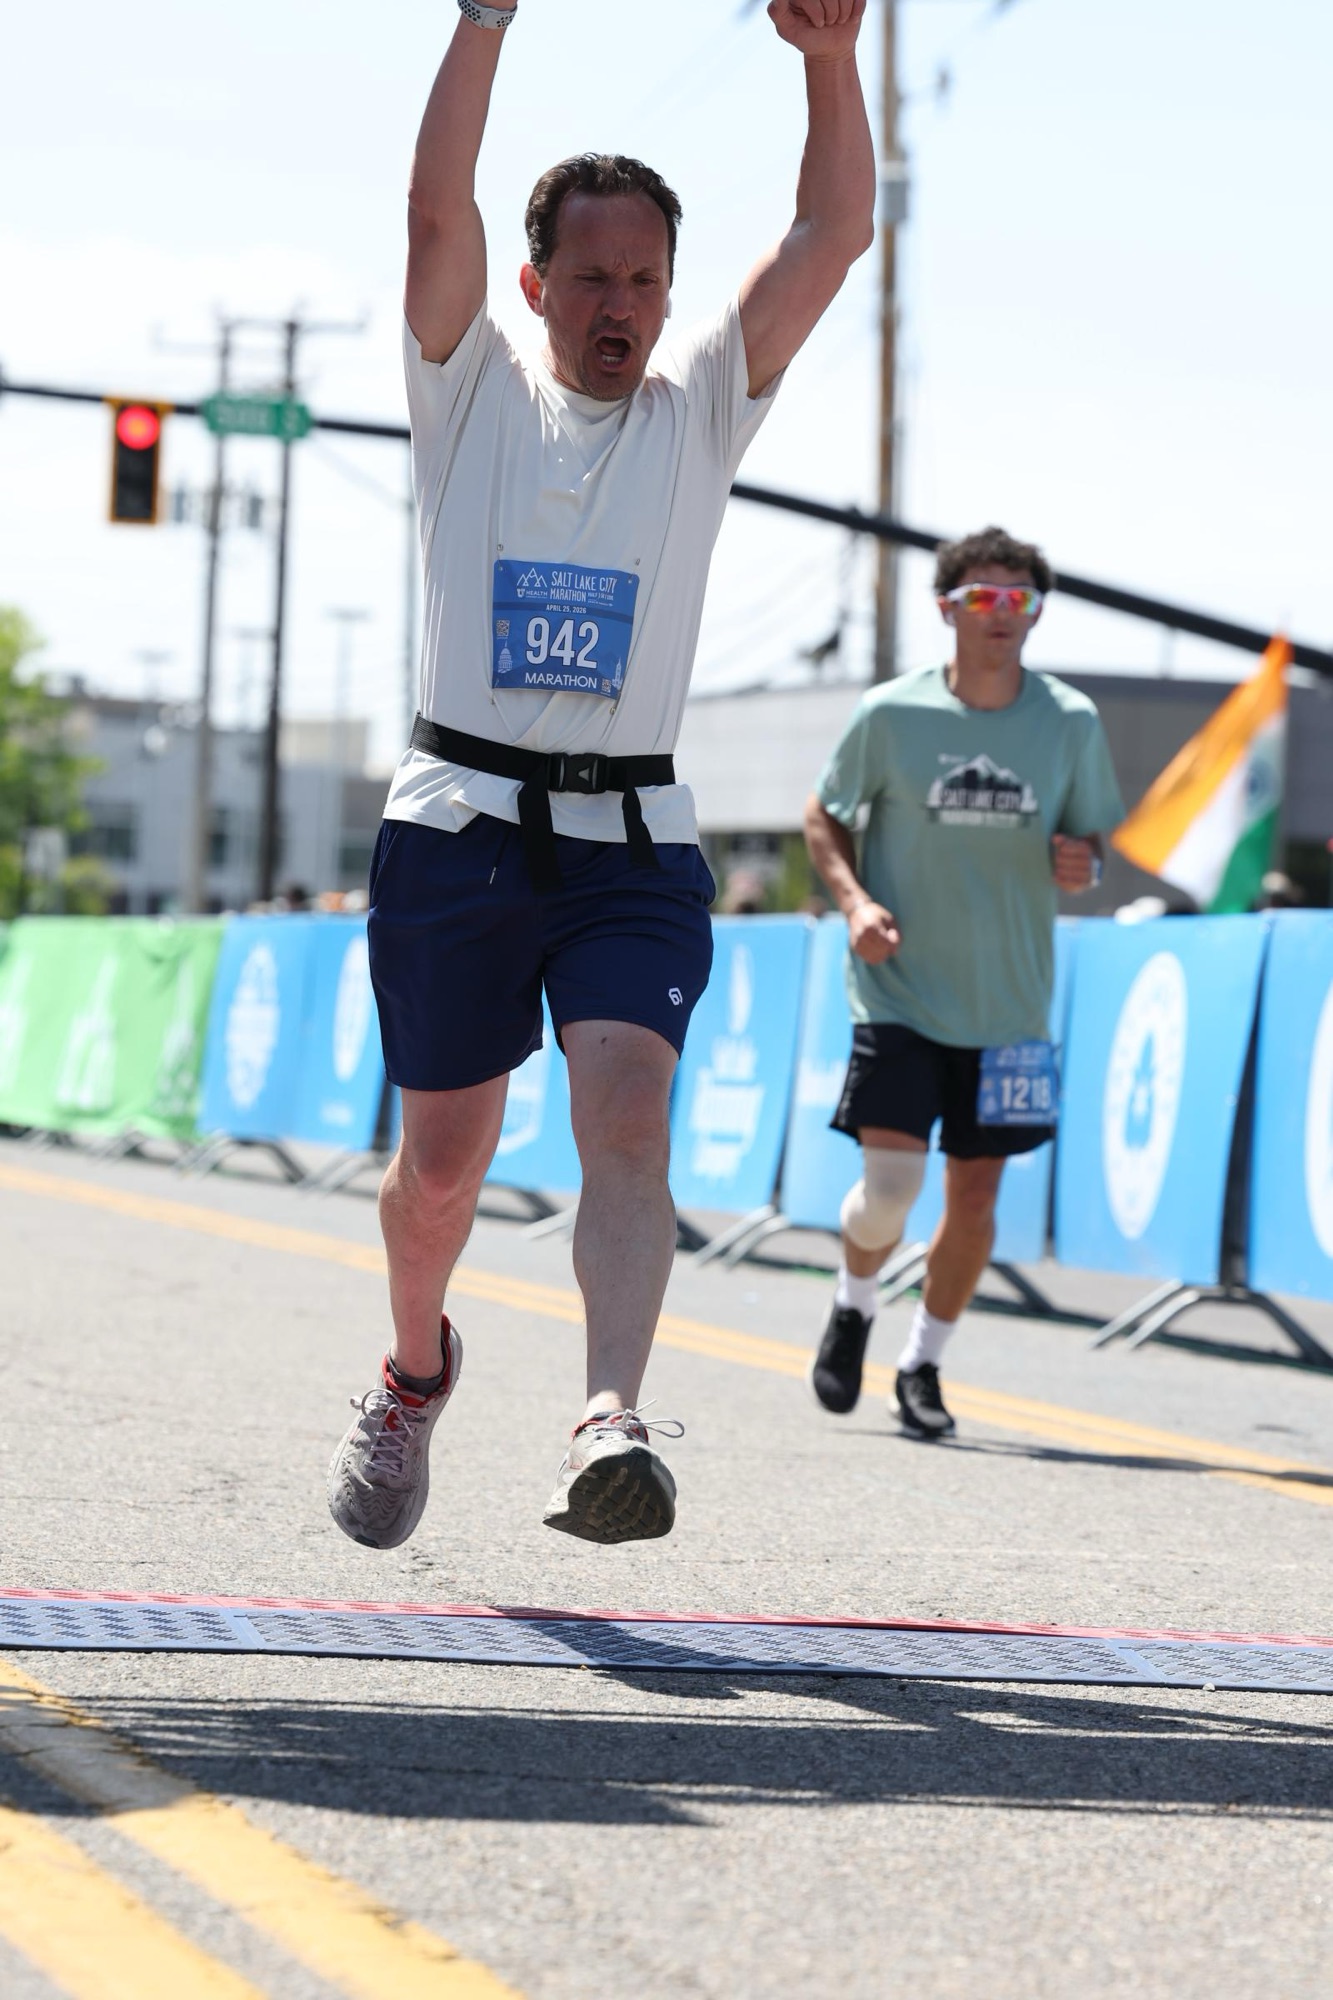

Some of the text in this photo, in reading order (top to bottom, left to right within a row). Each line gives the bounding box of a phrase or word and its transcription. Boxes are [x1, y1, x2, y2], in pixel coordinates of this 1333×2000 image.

[552, 571, 618, 593] SALT LAKE CITY
[550, 588, 586, 602] MARATHON
[546, 604, 562, 612] APRIL
[572, 606, 587, 614] 2026
[526, 617, 599, 669] 942
[525, 673, 597, 688] MARATHON
